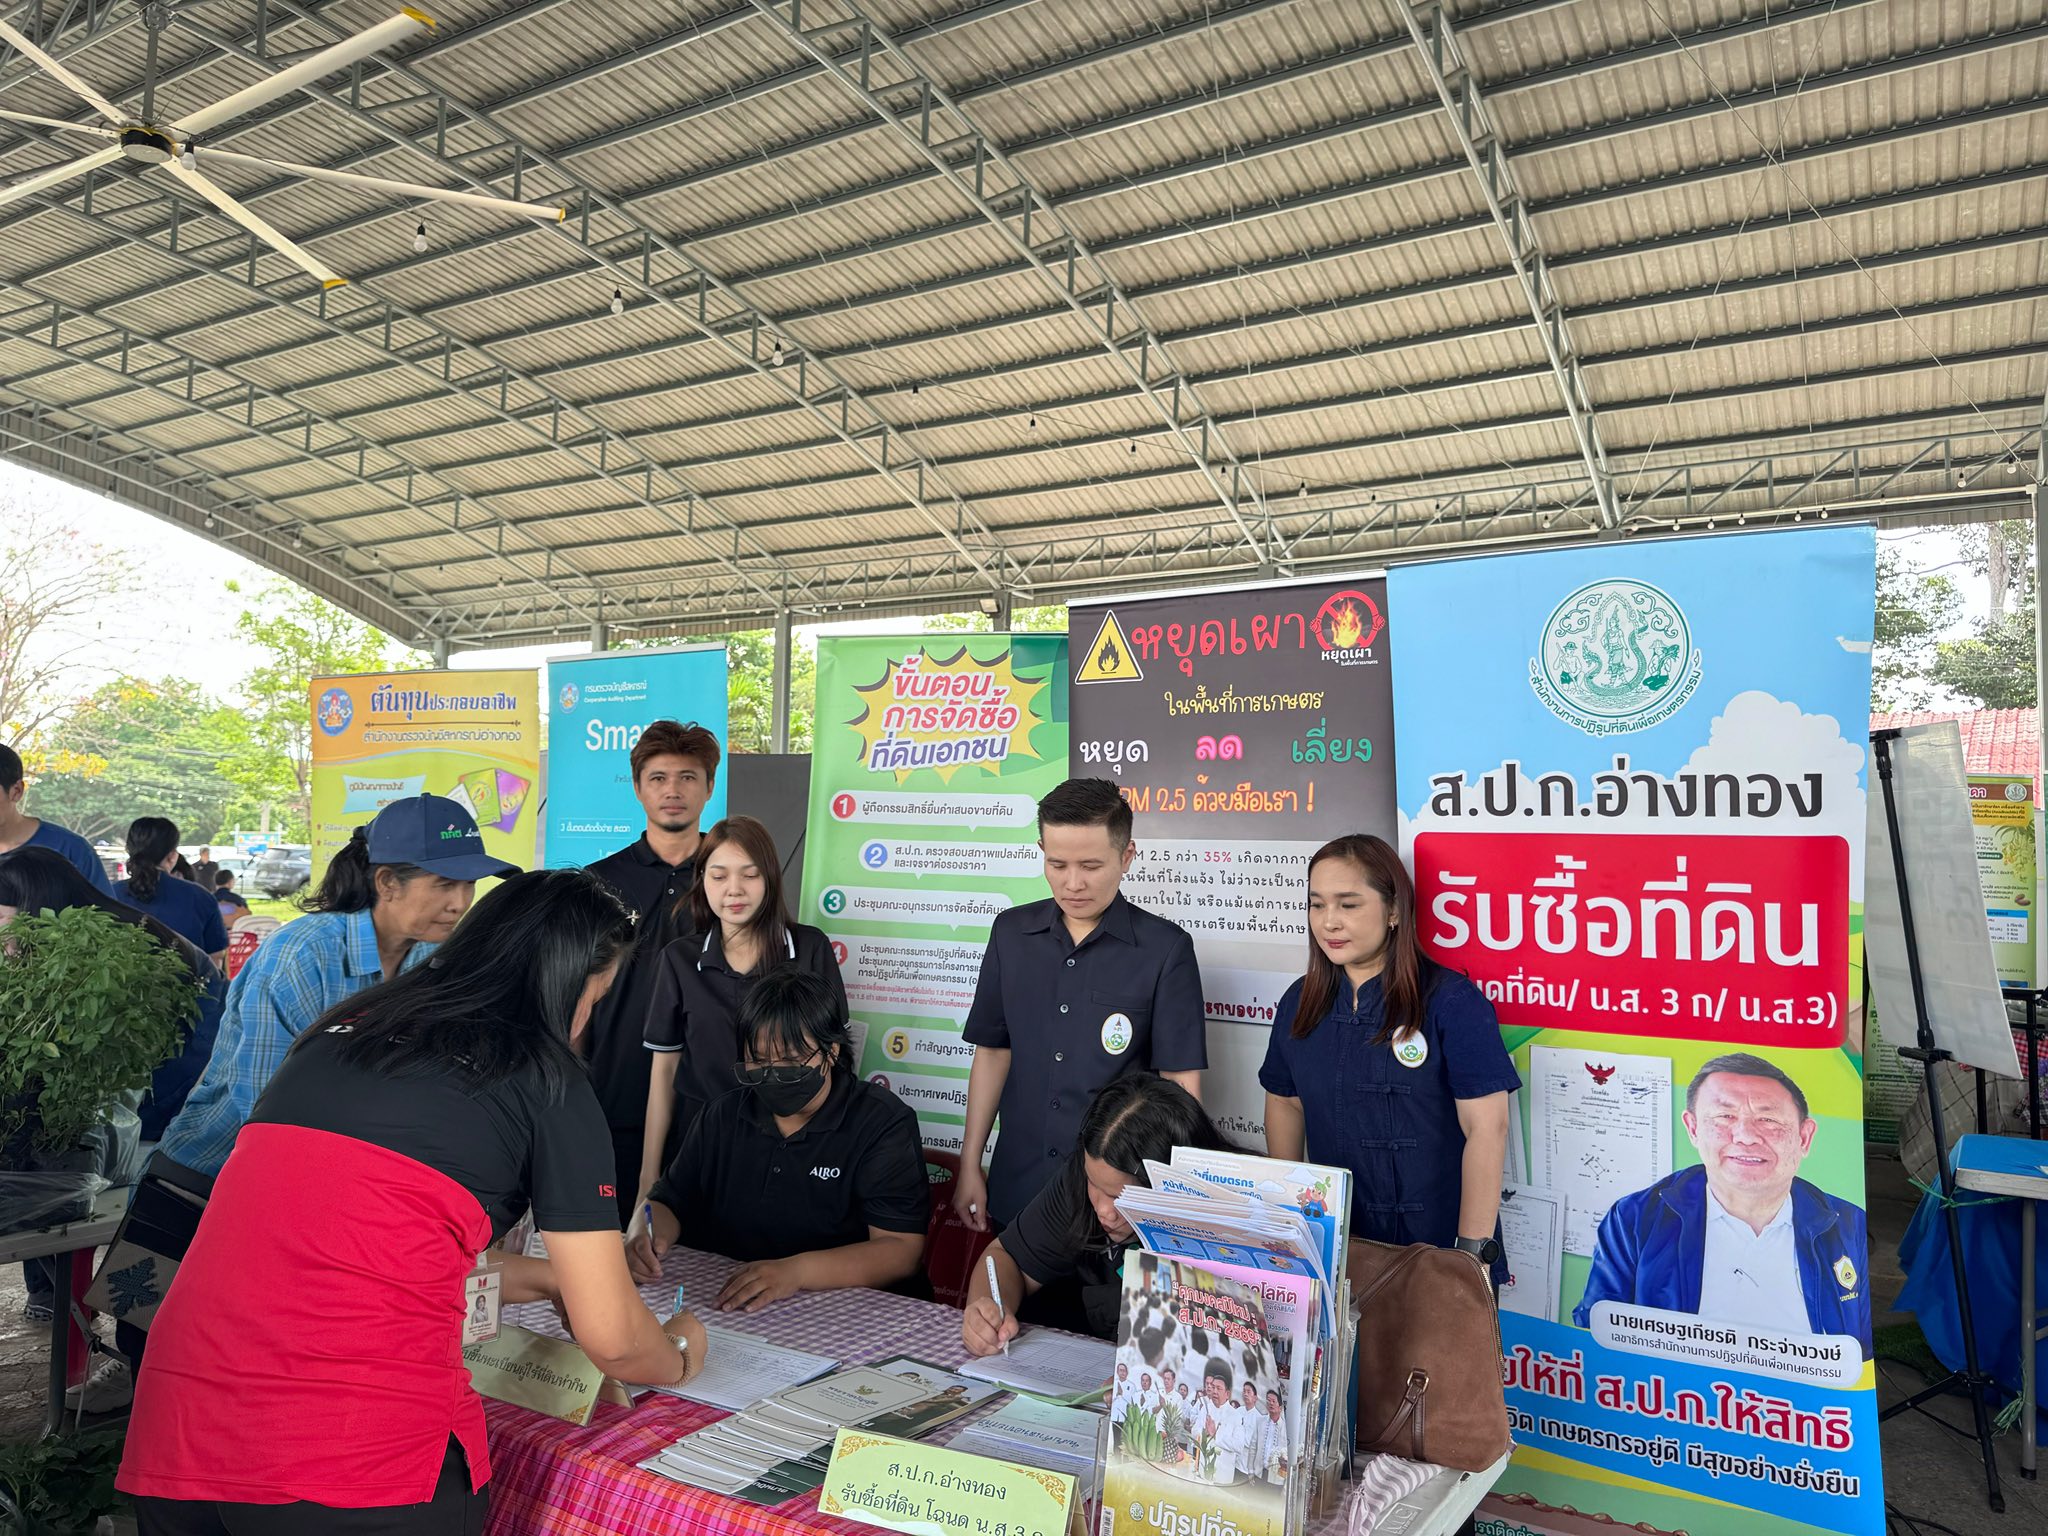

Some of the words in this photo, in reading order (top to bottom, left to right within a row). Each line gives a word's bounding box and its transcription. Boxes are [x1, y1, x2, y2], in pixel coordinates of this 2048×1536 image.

[1131, 613, 1305, 677] หยุดเผา
[1321, 648, 1372, 663] หยุดเผา
[893, 657, 992, 697] ขั้นตอน
[883, 689, 1018, 729] การจัดซื้อ
[1164, 684, 1325, 716] ในพื้นที่การเกษตร
[1531, 670, 1701, 736] สำนักงานการปฏิรูปที่ดินเพื่อเกษตรกรรม
[585, 719, 650, 750] Sma
[870, 731, 1007, 769] ที่ดินเอกชน
[1194, 733, 1244, 762] ลด
[1291, 717, 1373, 764] เลี่ยง
[1079, 740, 1149, 776] หยุด
[1156, 787, 1186, 813] 2.5
[1192, 774, 1298, 814] ด้วยมือเรา
[1306, 781, 1315, 813] !
[1431, 757, 1824, 818] ส.ป.ก.อ่างทอง
[839, 797, 848, 815] 1
[862, 801, 1013, 816] ผู้ถือกรรมสิทธิ์ยื่นคำเสนอขายที่ดิน
[869, 847, 882, 865] 2
[894, 858, 986, 871] และเจรจาต่อรองราคา
[895, 845, 923, 856] ส.ป.ก.
[925, 846, 1038, 860] ตรวจสอบสภาพแปลงที่ดิน
[1134, 850, 1144, 861] M
[1150, 850, 1171, 861] 2.5
[1176, 850, 1198, 862] กว่า
[1203, 851, 1232, 863] 35%
[1121, 866, 1214, 885] นพื้นที่โล่งแจ้ง
[828, 893, 841, 910] 3
[1431, 854, 1820, 967] รับซื้อที่ดิน
[858, 967, 967, 984] การปฏิรูปที่ดินเพื่อเกษตรกรรม
[1589, 987, 1649, 1014] น.ส.
[1661, 988, 1680, 1016] 3
[1691, 987, 1729, 1023] ก/
[1738, 991, 1839, 1029] น.ส.3)
[892, 1035, 904, 1054] 5
[915, 1039, 976, 1056] ทำสัญญาจะซื
[809, 1165, 841, 1180] ALRO
[1179, 1308, 1221, 1333] ส.ป.ก.
[1609, 1312, 1737, 1346] นายเศรษฐเกียรติ
[1747, 1334, 1842, 1362] กระจ่างวงษ์
[463, 1345, 587, 1394] บขึ้นทะเบียนผู้ไร้ที่ดินทำกิน
[1611, 1331, 1842, 1379] เลขาธิการสำนักงานการปฏิรูปที่ดินเพื่อเกษตรกรรม
[1598, 1377, 1852, 1451] ส.ป.ก.ให้สิทธิ
[1541, 1418, 1680, 1466] เกษตรกรอยู่ดี
[1688, 1444, 1859, 1497] มีสุขอย่างยั่งยืน
[887, 1463, 1007, 1500] ส.ป.ก.อ่างทอง
[841, 1482, 920, 1518] รับซื้อที่ดิน
[926, 1500, 969, 1529] โฉนด
[1148, 1500, 1251, 1536] ปฏิรปที่ิ
